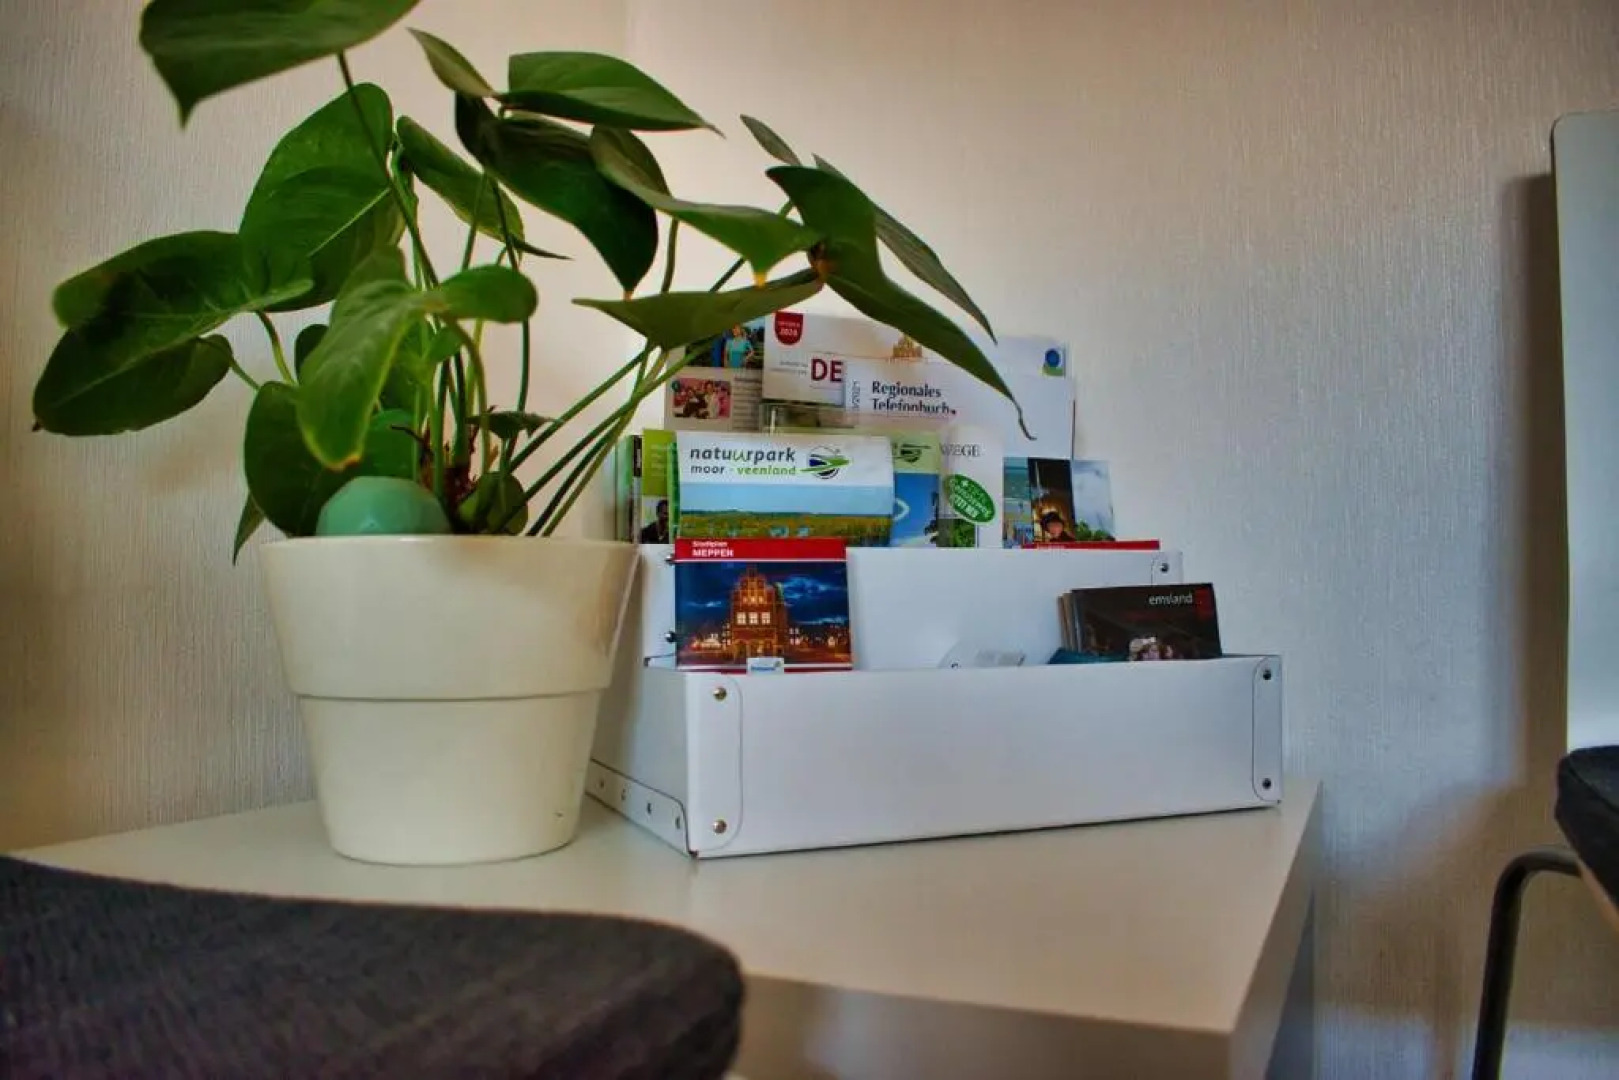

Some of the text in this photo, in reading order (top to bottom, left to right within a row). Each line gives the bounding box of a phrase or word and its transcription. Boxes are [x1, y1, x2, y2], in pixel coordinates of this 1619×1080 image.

[811, 358, 844, 383] DE
[872, 380, 942, 398] Regionales
[690, 447, 796, 465] natuurpark
[690, 465, 725, 474] moor
[737, 465, 796, 475] veenland
[692, 548, 734, 557] MEPPEN
[1148, 591, 1193, 605] emsland
